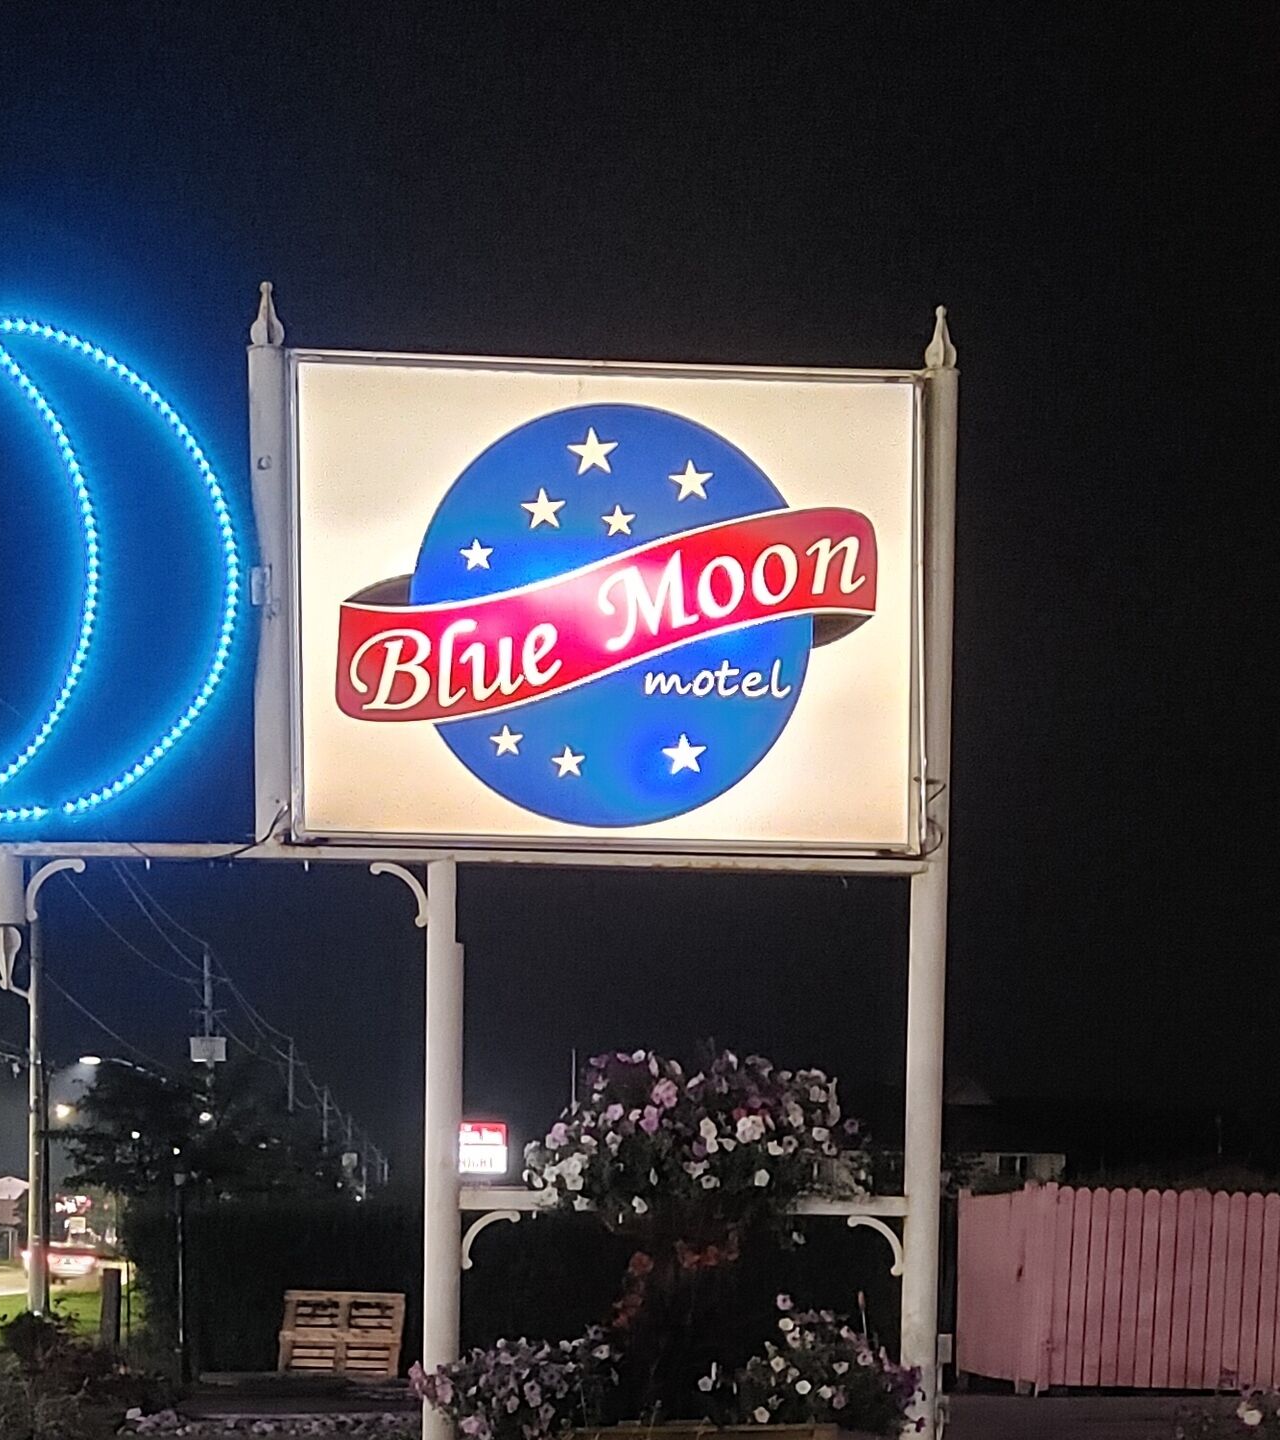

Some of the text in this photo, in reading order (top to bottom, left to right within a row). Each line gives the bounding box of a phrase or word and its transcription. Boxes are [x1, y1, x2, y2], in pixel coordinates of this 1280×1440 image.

[350, 536, 865, 710] Blue Moon
[644, 660, 791, 699] motel
